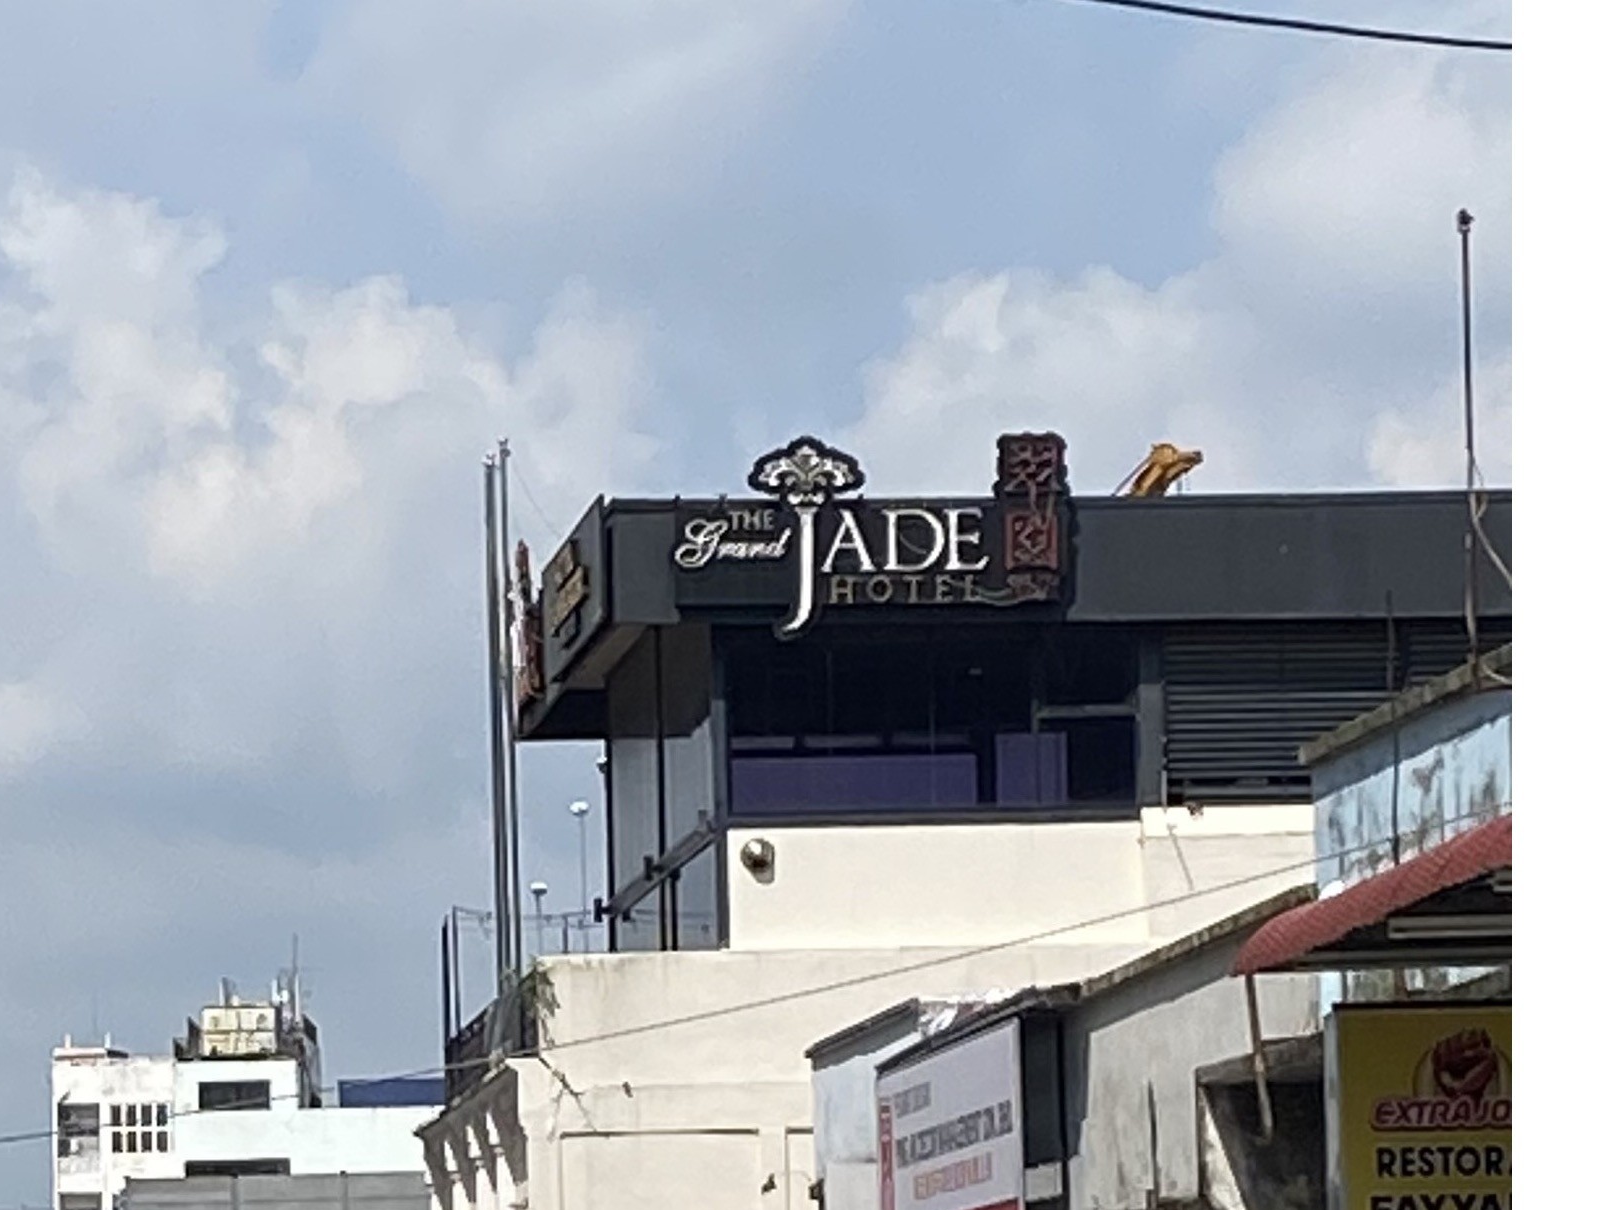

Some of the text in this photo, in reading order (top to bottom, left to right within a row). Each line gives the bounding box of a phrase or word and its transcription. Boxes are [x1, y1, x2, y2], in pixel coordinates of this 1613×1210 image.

[730, 510, 774, 531] THE
[675, 518, 791, 568] Grand
[781, 505, 989, 634] JADE
[829, 573, 981, 604] HOTEL
[1376, 1146, 1512, 1177] RESTOR
